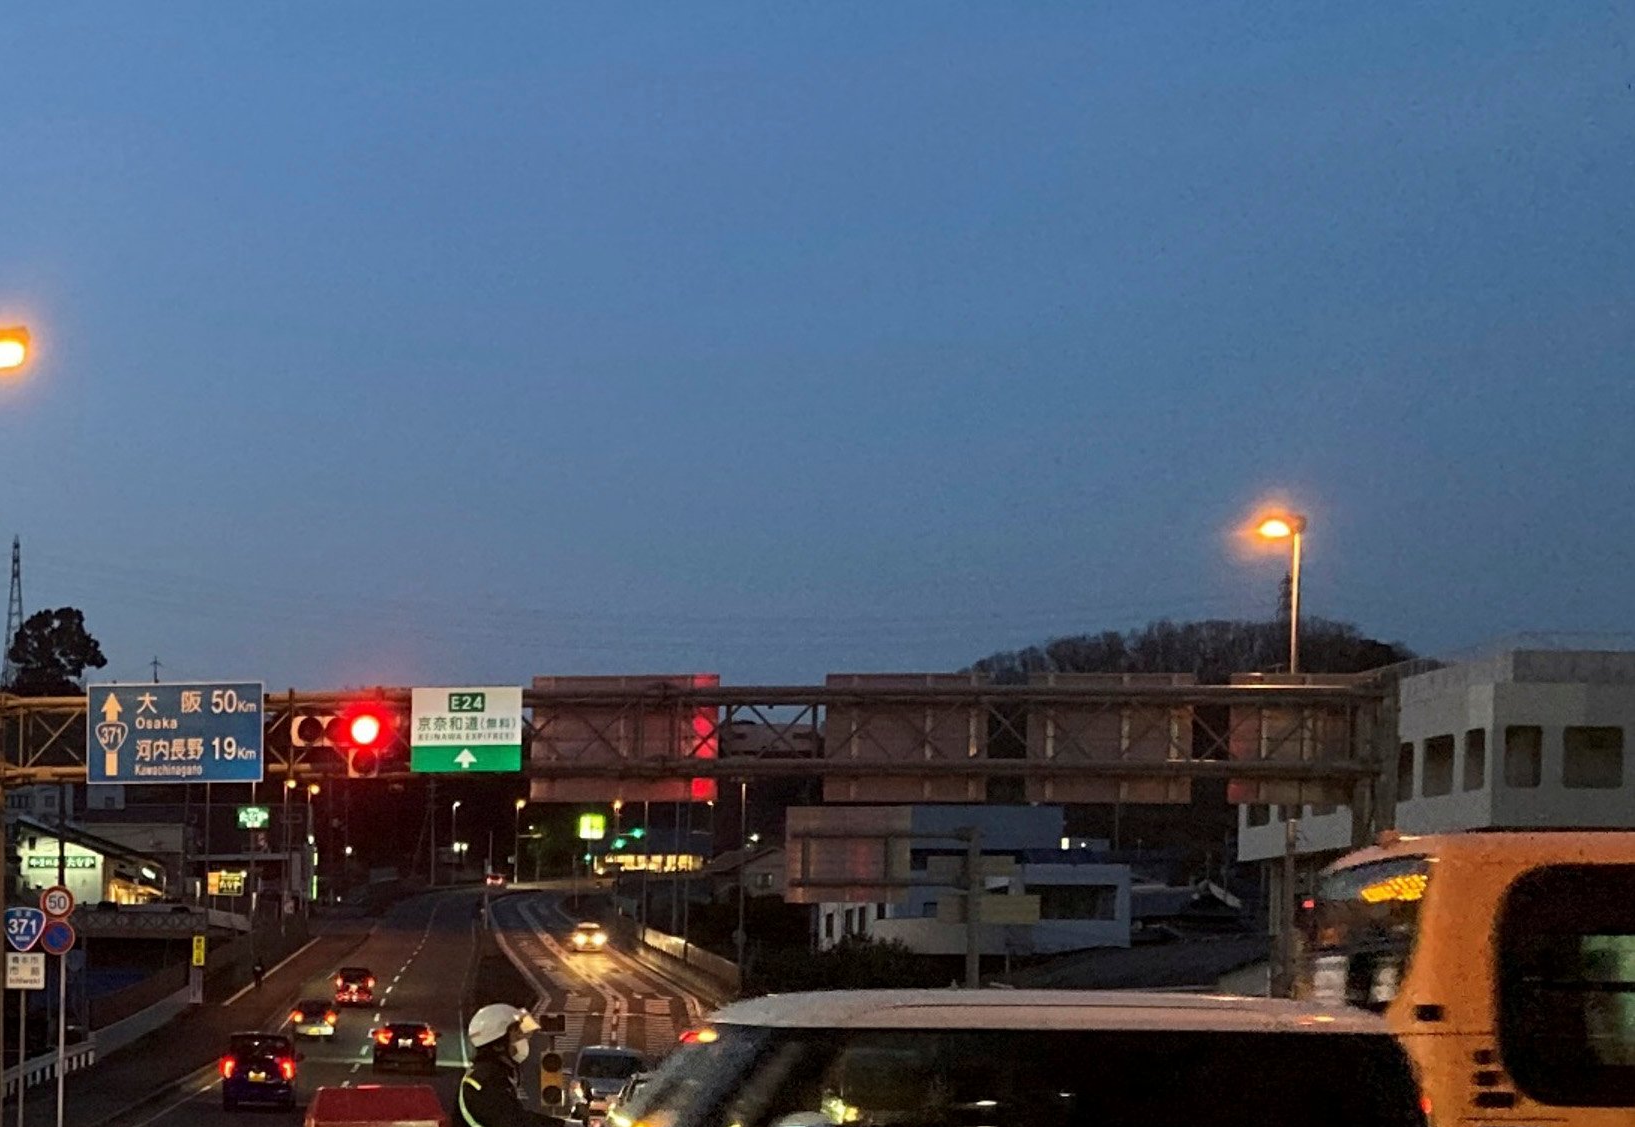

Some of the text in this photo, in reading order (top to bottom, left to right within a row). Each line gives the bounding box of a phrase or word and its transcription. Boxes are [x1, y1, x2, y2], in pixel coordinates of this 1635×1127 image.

[136, 690, 202, 713] 大阪
[451, 696, 483, 710] E24
[135, 717, 178, 729] Osaka
[101, 726, 123, 744] 371
[136, 738, 204, 761] 河内長野
[135, 764, 203, 777] Kawachinagano
[48, 896, 66, 910] 50
[8, 918, 37, 935] 371
